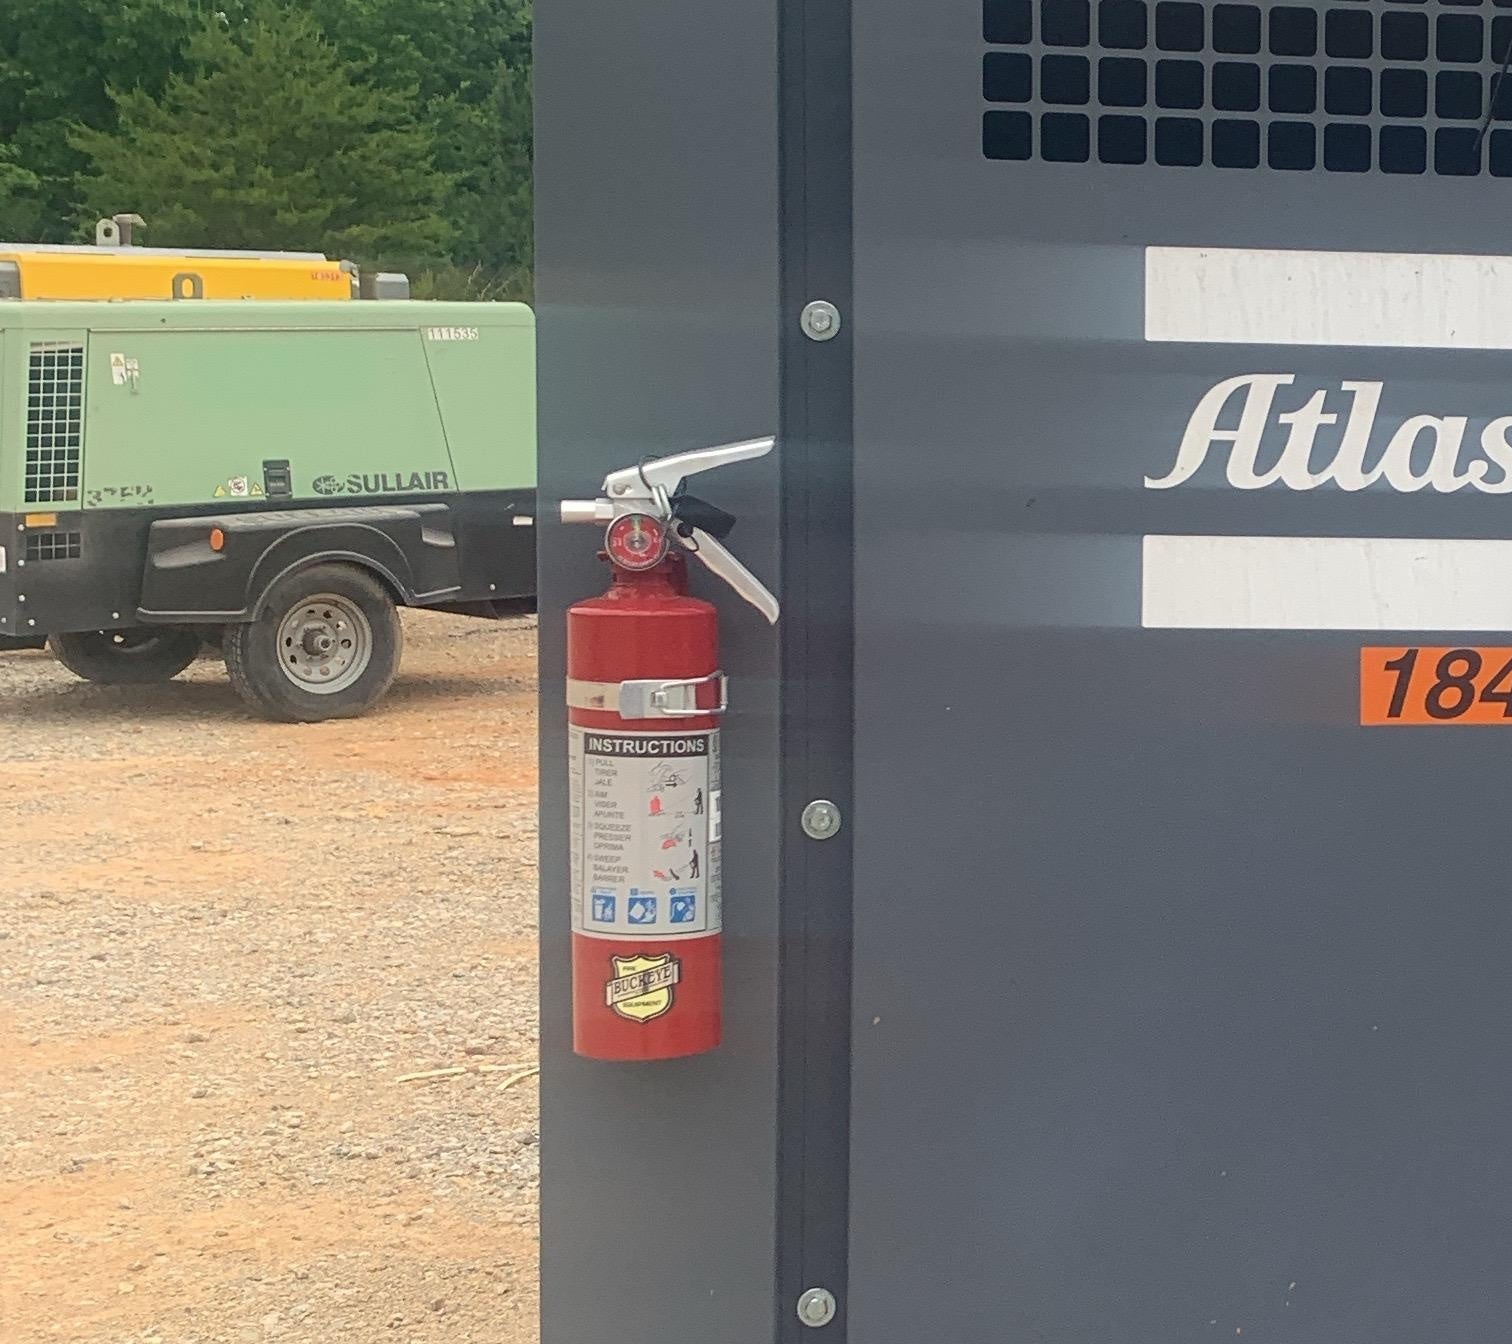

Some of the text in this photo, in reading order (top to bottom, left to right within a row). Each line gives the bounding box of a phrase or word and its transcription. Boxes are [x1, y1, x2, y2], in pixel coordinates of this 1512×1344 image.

[346, 471, 450, 495] SULLAIR
[588, 737, 705, 754] INSTRUCTIONS
[613, 963, 672, 995] BUCKEYE
